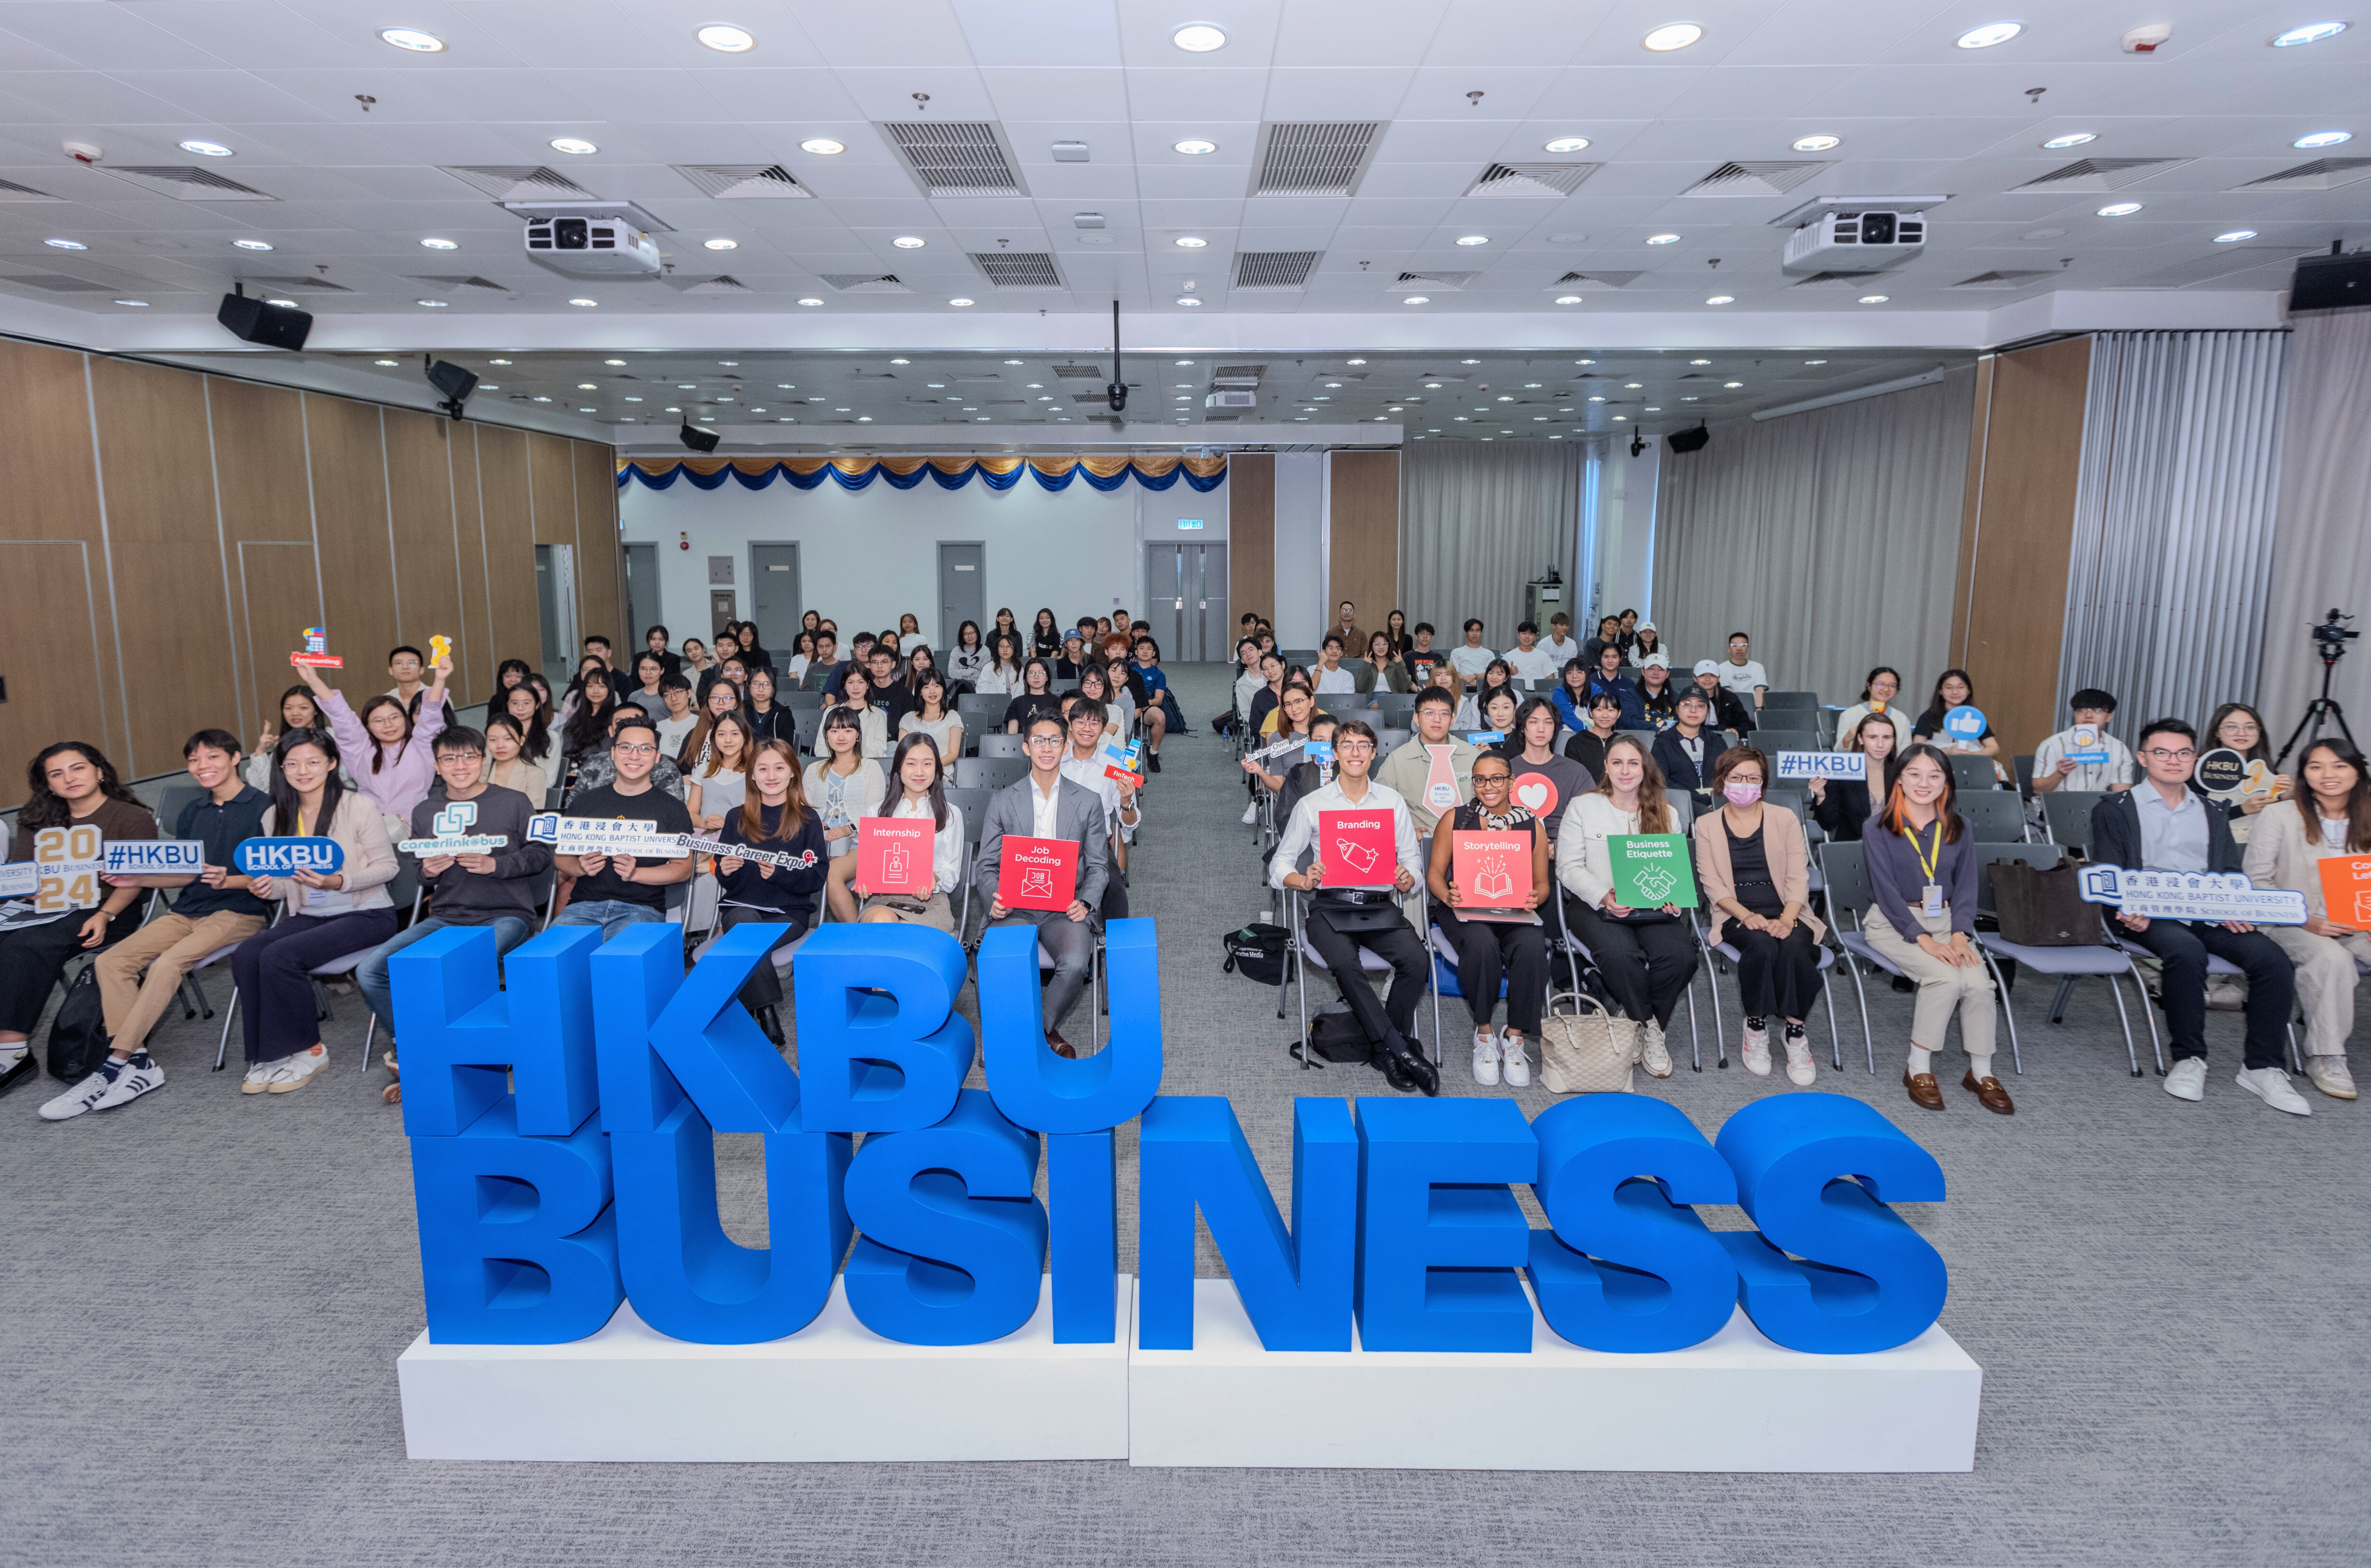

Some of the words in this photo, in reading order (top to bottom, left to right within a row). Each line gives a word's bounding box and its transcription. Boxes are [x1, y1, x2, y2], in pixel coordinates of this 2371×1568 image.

[295, 657, 340, 666] Accounting
[1256, 747, 1271, 757] Your
[1273, 740, 1288, 750] Own
[1271, 746, 1292, 757] Career
[1781, 755, 1862, 774] #HKBU
[2206, 761, 2239, 771] HKBU
[1113, 770, 1135, 782] FinTech
[564, 820, 654, 832] 香港浸會大學
[1337, 820, 1380, 830] Branding
[873, 828, 921, 840] Internship
[39, 828, 95, 862] 20
[401, 837, 505, 849] careerlink@bus
[1464, 841, 1521, 852] Storytelling
[1627, 840, 1670, 849] Business
[246, 845, 333, 865] HKBU
[676, 834, 732, 854] Business
[735, 845, 775, 862] Career
[776, 853, 805, 869] Expo
[1031, 846, 1049, 855] Job
[1627, 850, 1673, 859] Etiquette
[108, 846, 198, 870] #HKBU
[1015, 854, 1061, 866] Decoding
[39, 864, 60, 874] KBU
[2351, 861, 2371, 870] Co
[2125, 875, 2245, 890] 香港浸會大學
[40, 874, 94, 909] 24
[2126, 890, 2153, 899] HONG
[2157, 891, 2184, 900] KONG
[2188, 893, 2231, 902] BAPTIST
[2234, 894, 2297, 904] UNIVERSITY
[2129, 904, 2196, 914] 工商管理學院
[2200, 908, 2237, 916] SCHOOL
[2255, 910, 2300, 919] BUSINESS
[388, 918, 1164, 1136] HKBU
[410, 1091, 1947, 1355] BUSINESS
